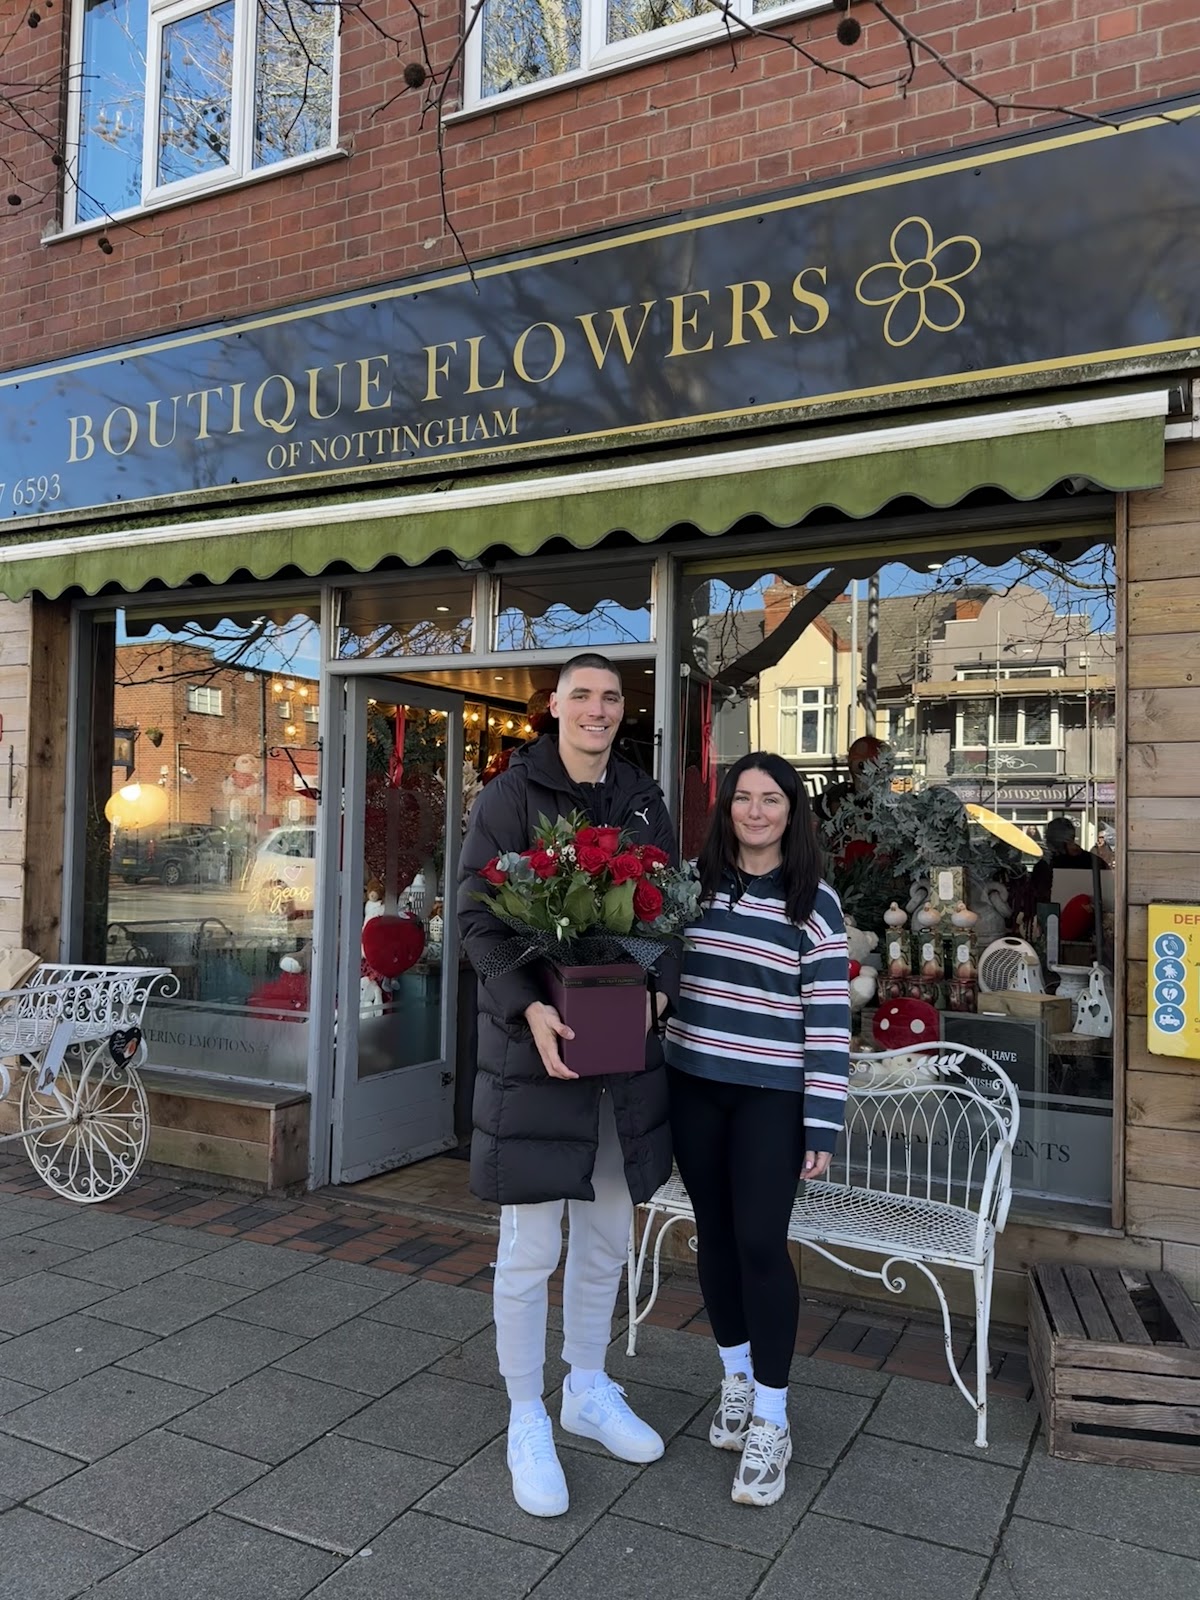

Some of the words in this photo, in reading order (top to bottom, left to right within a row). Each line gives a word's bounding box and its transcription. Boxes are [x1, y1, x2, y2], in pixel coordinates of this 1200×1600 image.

[66, 354, 393, 463] BOUTIQUE
[420, 265, 831, 403] FLOWERS
[266, 442, 304, 471] OF
[309, 407, 520, 464] NOTTINGHAM
[12, 473, 61, 506] 6593
[189, 1035, 255, 1054] EMOTIONS
[991, 1049, 1018, 1062] HAVE
